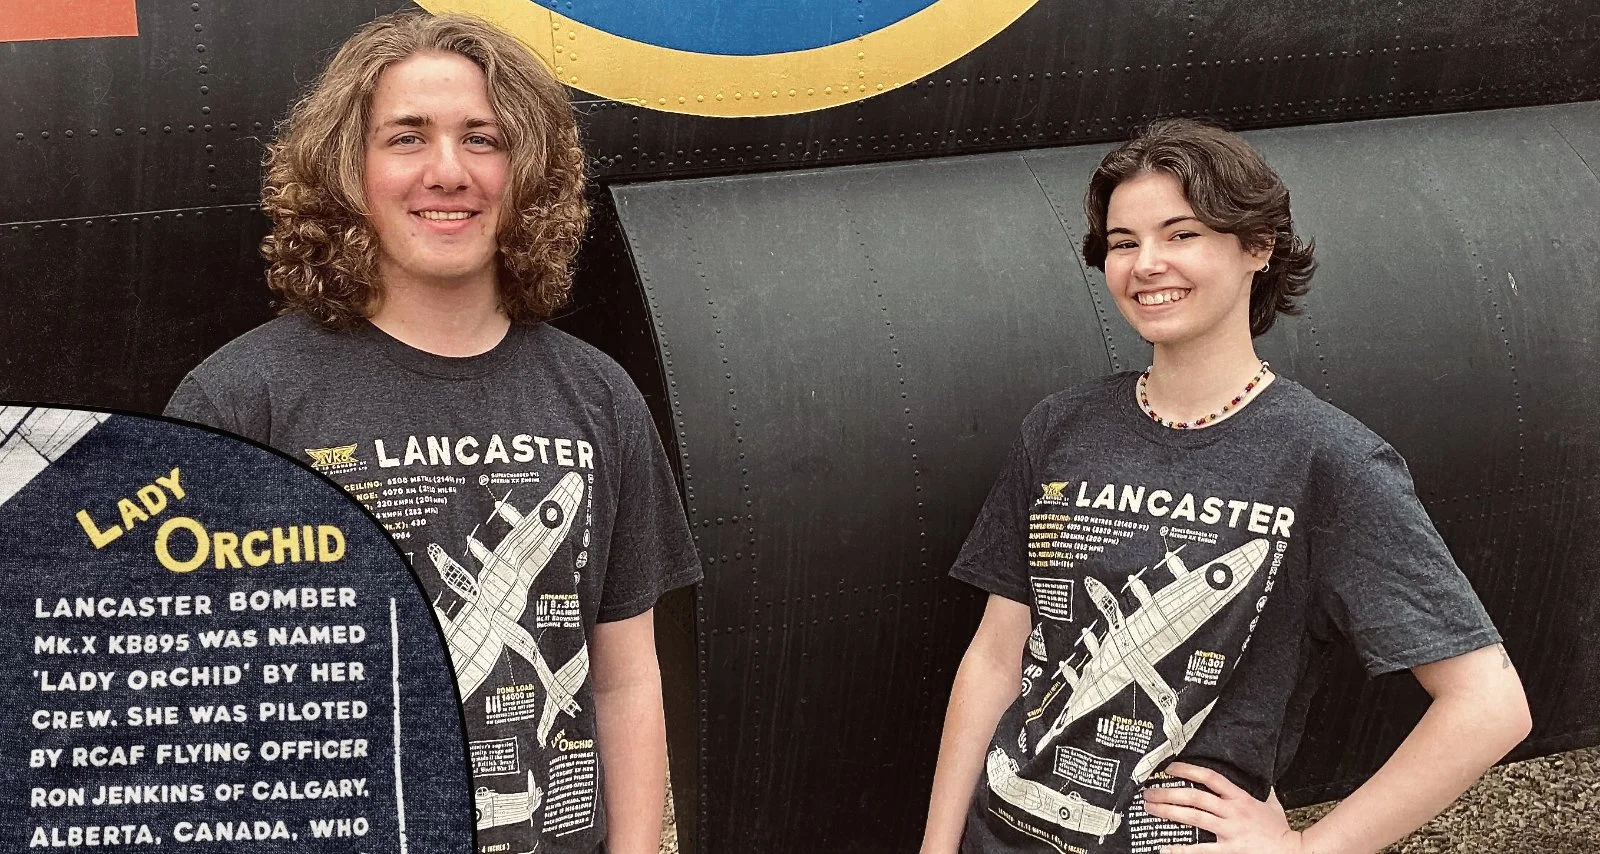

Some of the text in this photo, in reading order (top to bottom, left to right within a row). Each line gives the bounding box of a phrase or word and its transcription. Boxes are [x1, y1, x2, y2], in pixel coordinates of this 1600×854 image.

[375, 434, 594, 470] LANCASTER
[75, 467, 187, 551] LADY
[1075, 480, 1294, 542] LANCASTER
[155, 516, 346, 573] ORCHID
[35, 587, 358, 619] LANCASTER BOMBER
[108, 635, 191, 656] KB895
[197, 630, 259, 651] WAS
[268, 624, 366, 648] NAMED
[263, 663, 299, 685] BY
[310, 661, 366, 683] HER
[1024, 663, 1043, 680] HP
[31, 700, 368, 731] CREW. SHE WAS PILOTED
[28, 738, 369, 768] BY RCAF FLYING OFFICER
[558, 738, 594, 752] ORCHID
[30, 787, 85, 809] RON
[91, 784, 205, 806] JENKINS
[214, 783, 246, 802] OF
[309, 817, 370, 840] WHO
